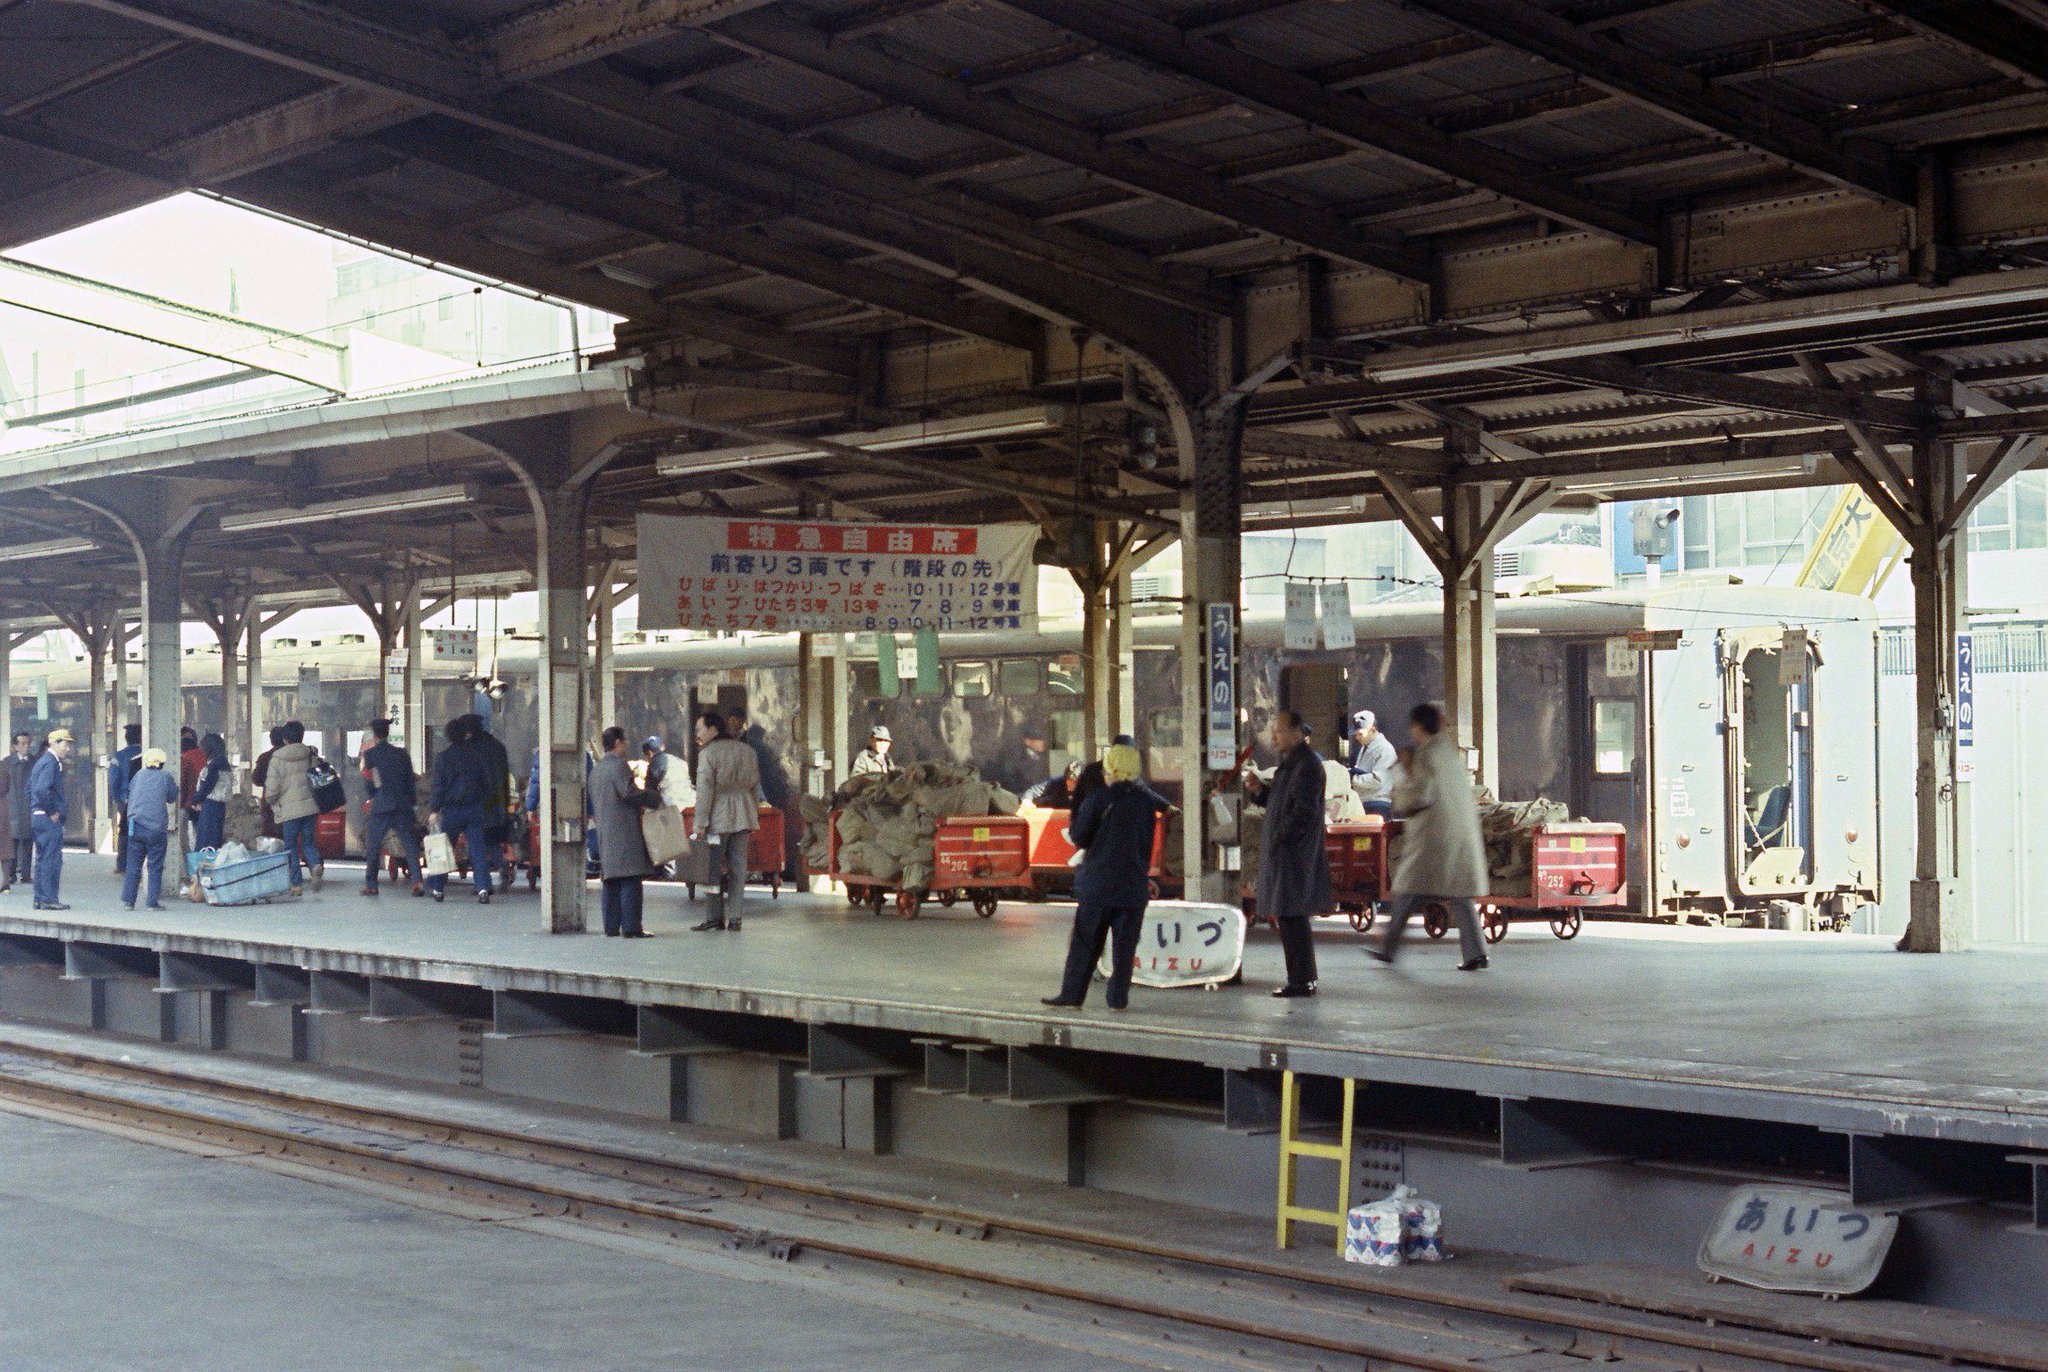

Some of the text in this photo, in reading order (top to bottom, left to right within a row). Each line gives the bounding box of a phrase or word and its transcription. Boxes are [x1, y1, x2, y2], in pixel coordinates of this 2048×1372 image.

[748, 525, 959, 553] 特急自由席
[1213, 613, 1229, 704] うえの
[1959, 642, 1972, 724] うえの
[1547, 875, 1564, 888] 252
[1140, 916, 1226, 949] いづ
[1270, 1052, 1278, 1067] 3
[1742, 1243, 1833, 1269] AIZU
